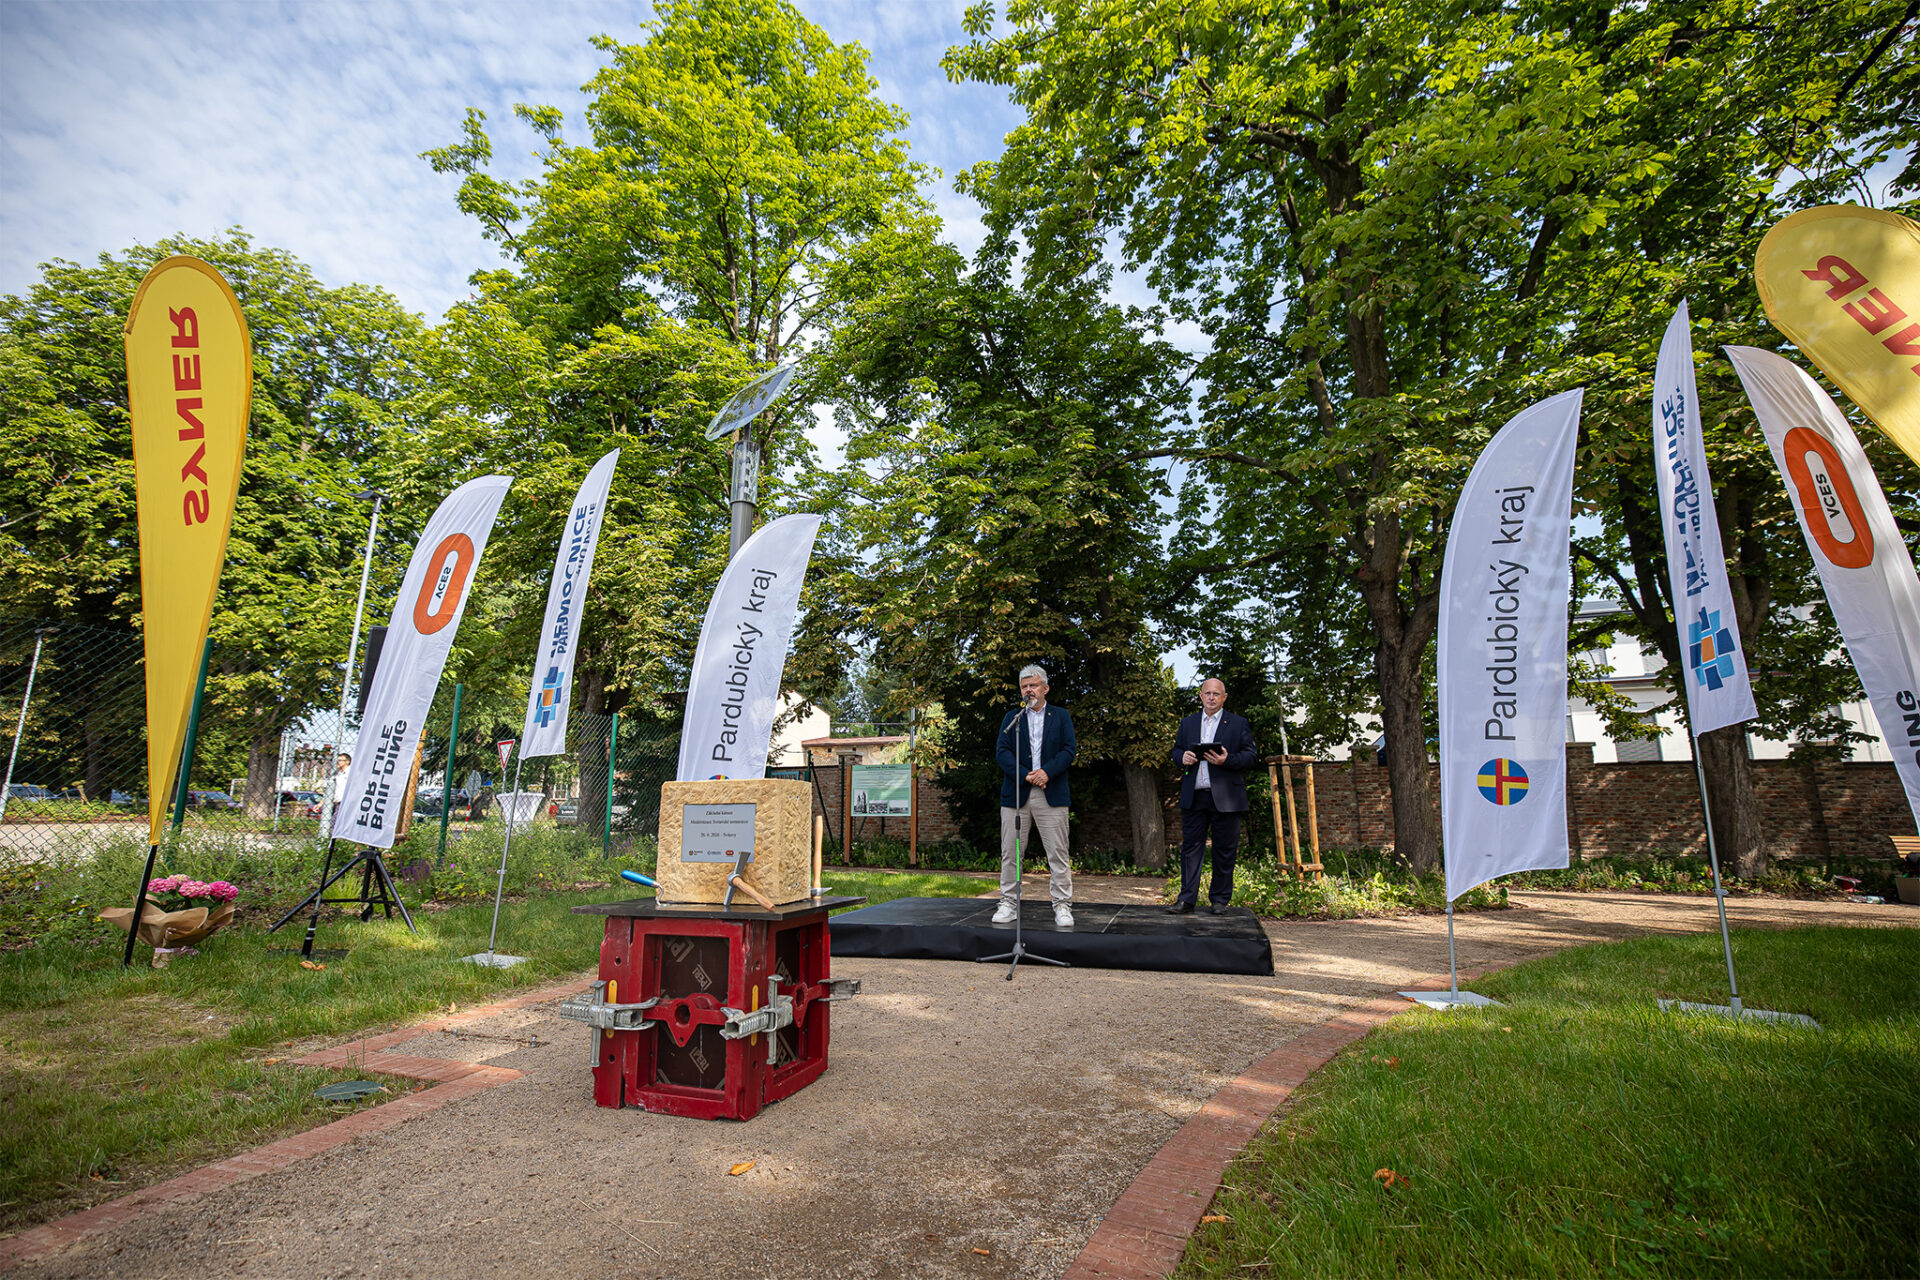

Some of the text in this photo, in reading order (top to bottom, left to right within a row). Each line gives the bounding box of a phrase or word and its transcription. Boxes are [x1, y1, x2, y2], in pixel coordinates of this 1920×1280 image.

[1816, 473, 1841, 519] VCES
[712, 568, 778, 762] Pardubický kraj
[1485, 485, 1535, 742] Pardubický kraj
[693, 1049, 710, 1071] PERI
